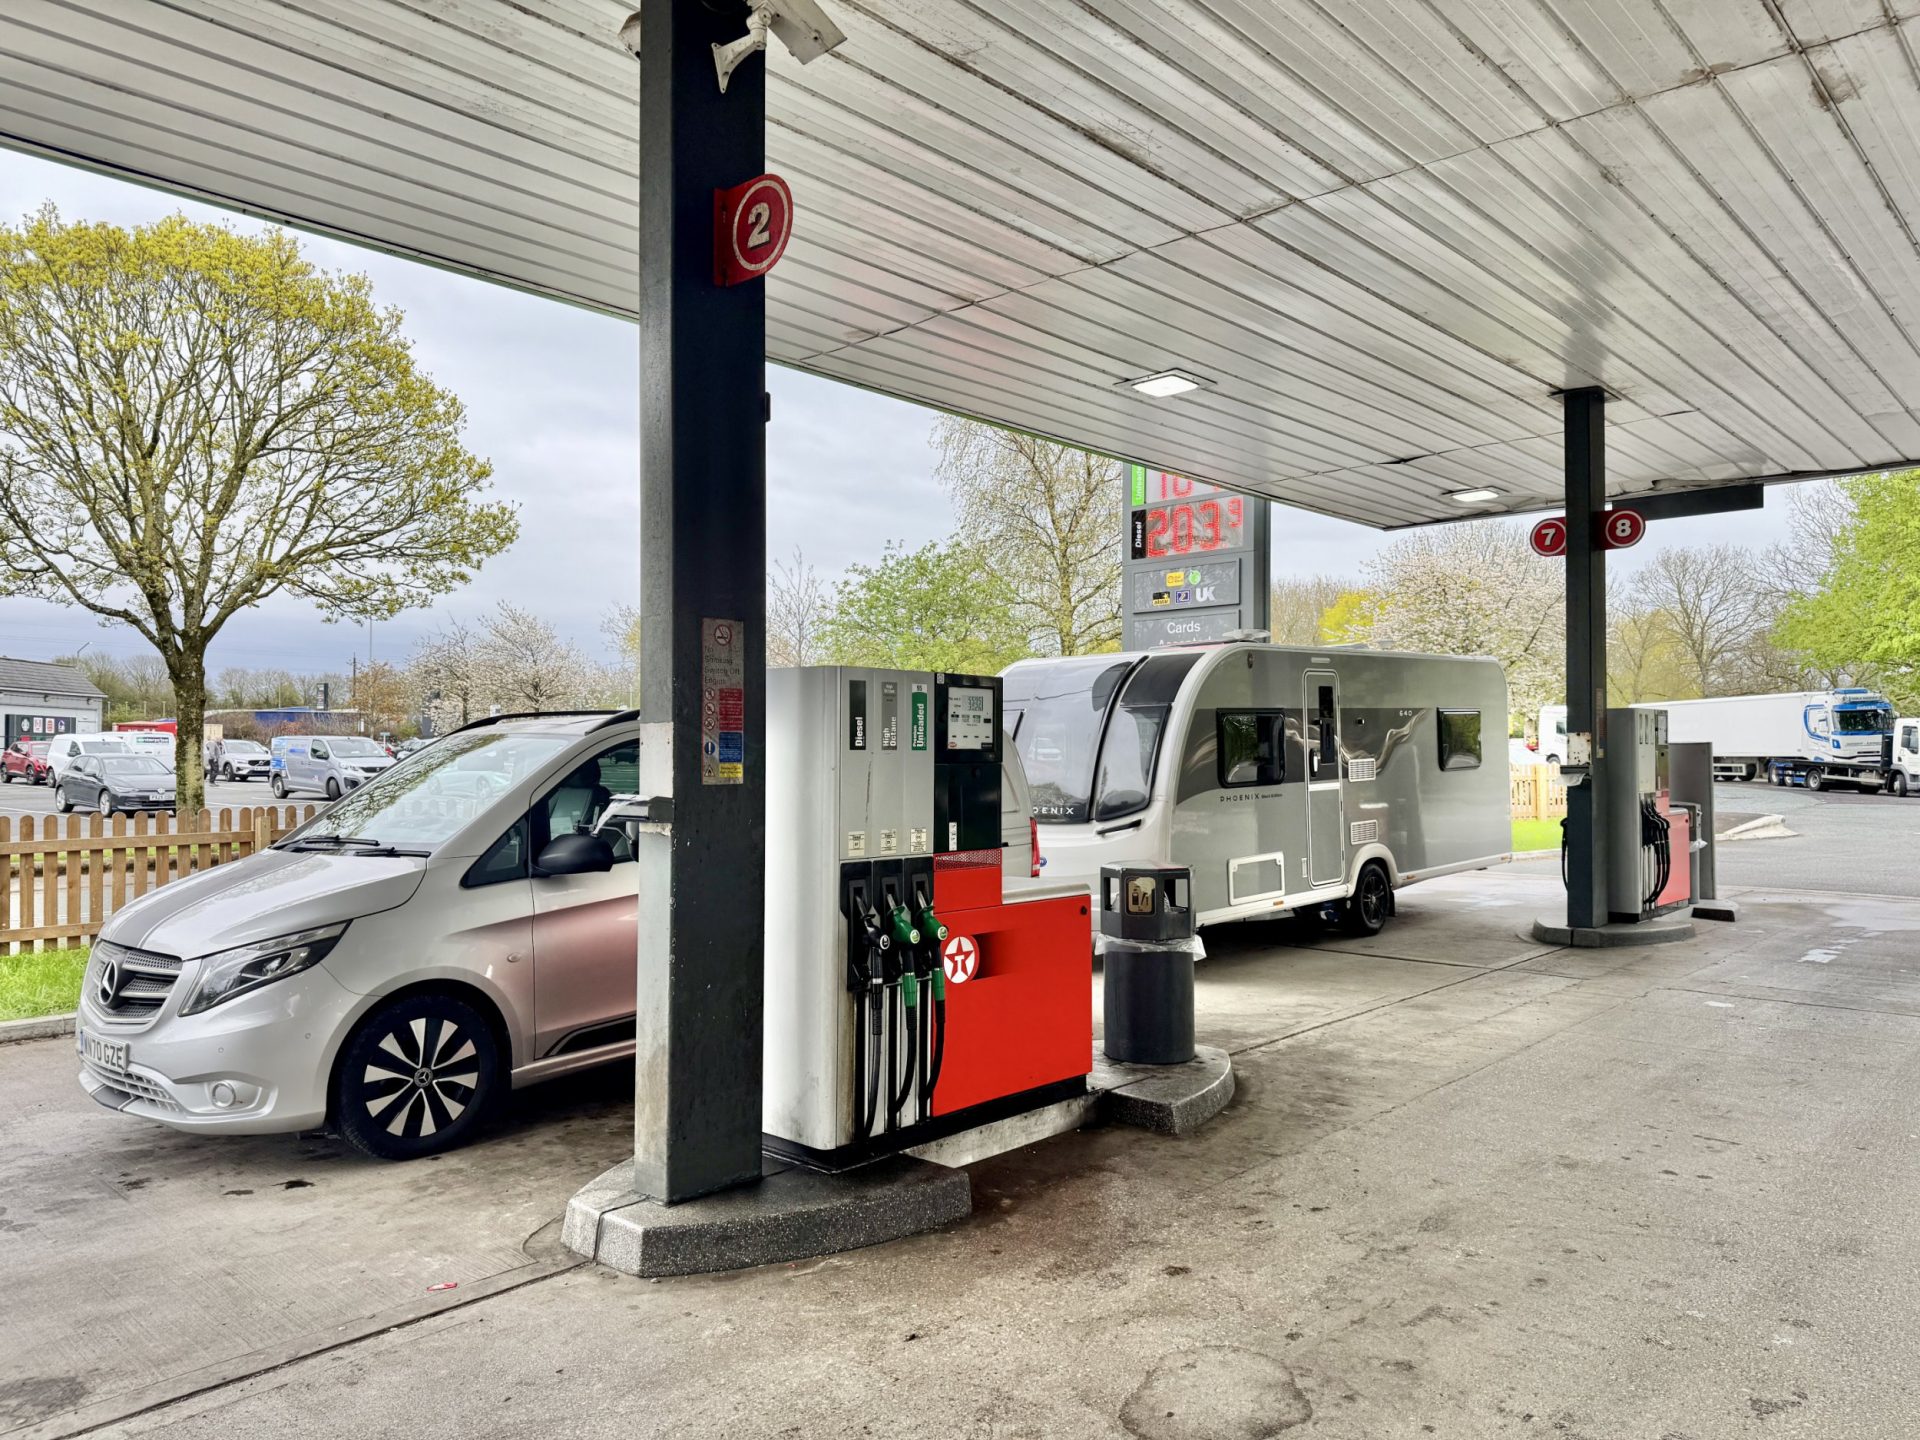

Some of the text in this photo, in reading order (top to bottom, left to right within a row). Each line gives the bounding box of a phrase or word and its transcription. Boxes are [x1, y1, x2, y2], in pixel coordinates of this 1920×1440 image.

[747, 202, 770, 249] 2
[1135, 521, 1143, 548] Diesel
[1541, 527, 1556, 546] 7
[1615, 518, 1632, 538] 8
[1195, 586, 1217, 602] UK
[1167, 621, 1201, 634] Cards
[855, 716, 864, 747] Diesel
[917, 703, 925, 747] Unleaded
[882, 727, 890, 747] High
[1220, 792, 1260, 802] PHOENIX
[1032, 806, 1074, 815] OENIX
[104, 1043, 124, 1070] GZE
